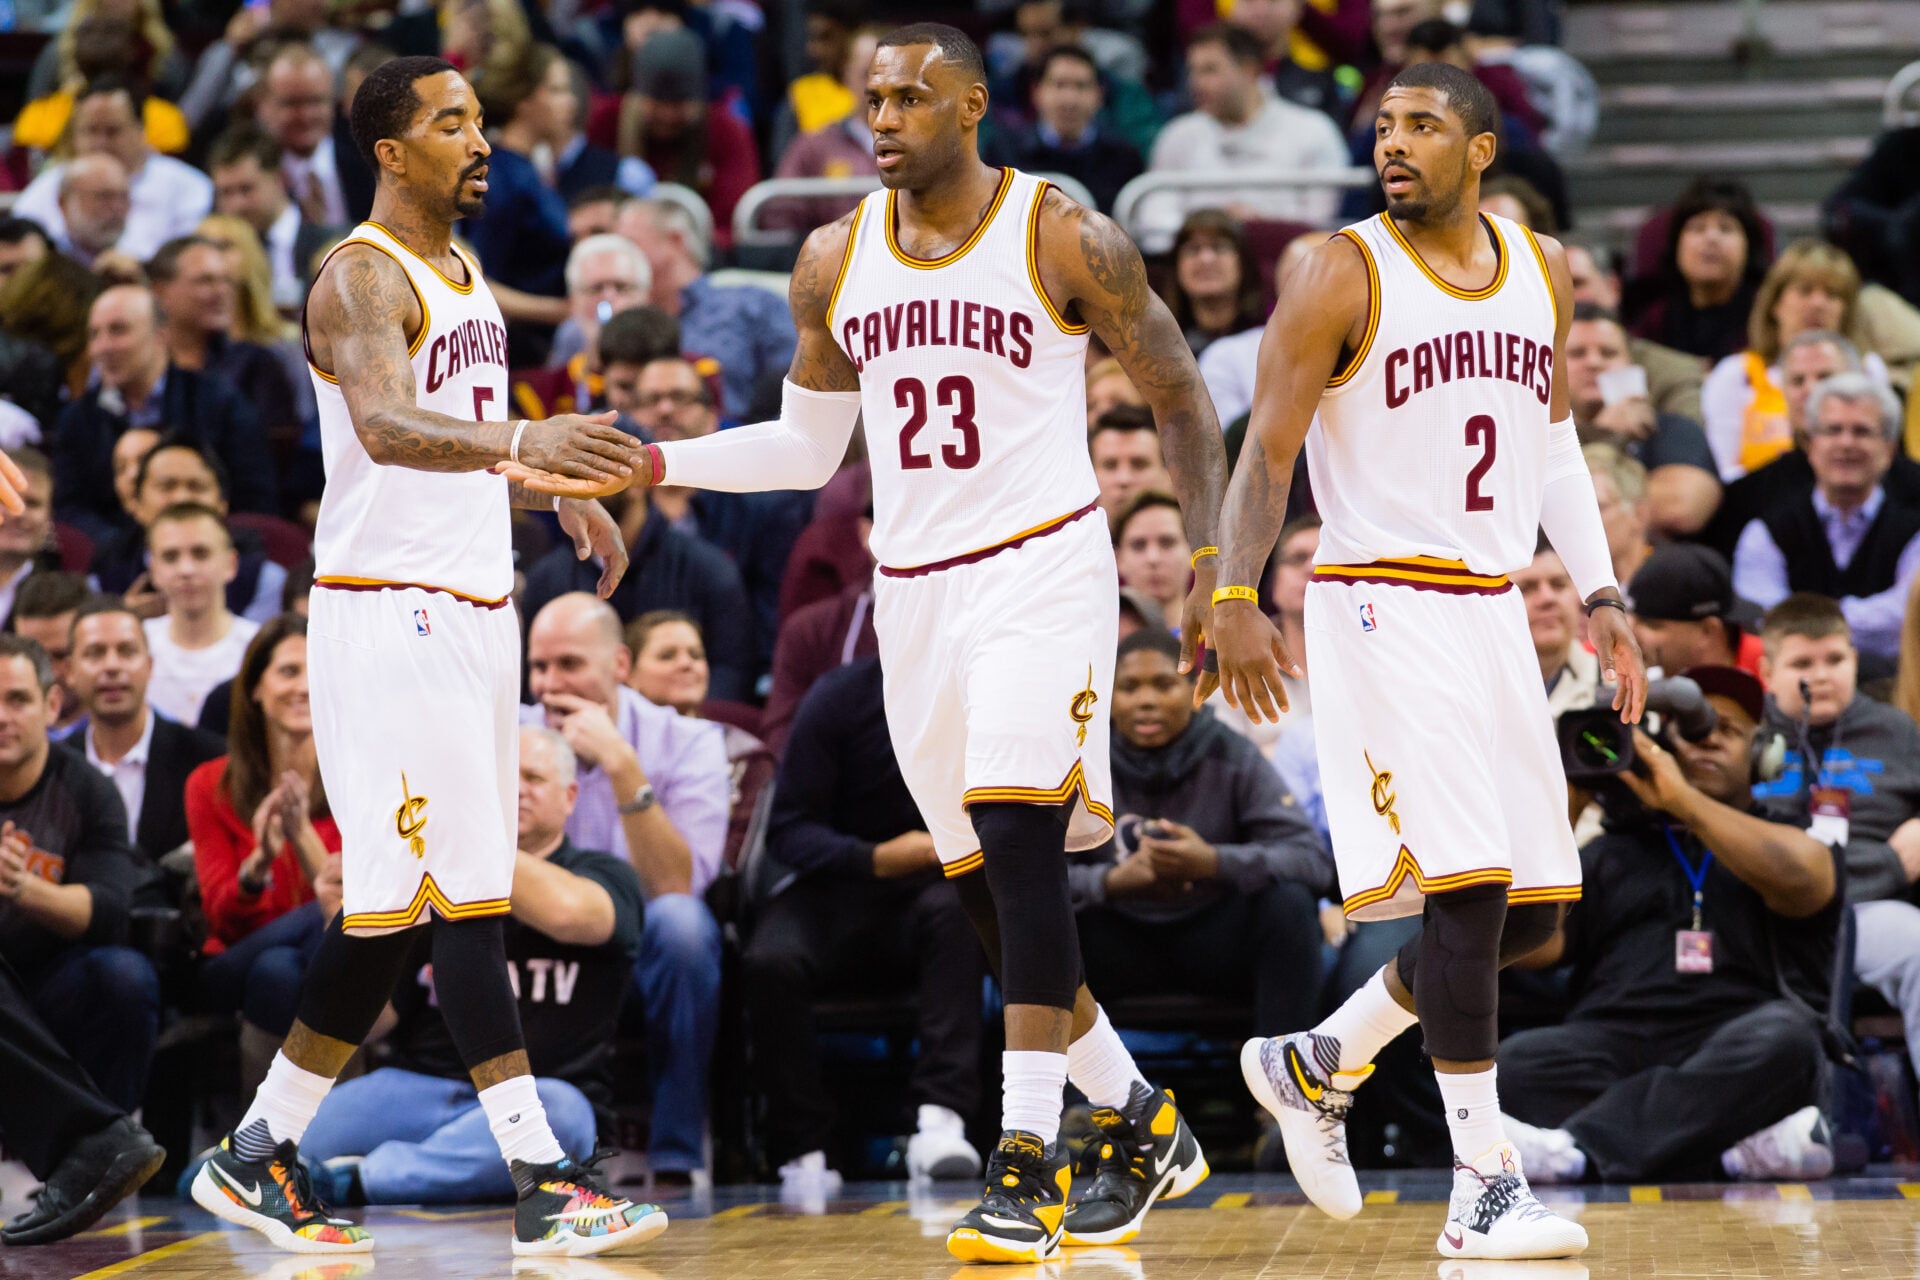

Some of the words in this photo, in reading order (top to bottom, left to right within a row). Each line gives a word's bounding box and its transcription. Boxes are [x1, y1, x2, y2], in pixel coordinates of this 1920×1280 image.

[843, 299, 1034, 374] CAVALIERS
[1384, 330, 1553, 410] CAVALIERS
[893, 375, 981, 470] 23
[1465, 414, 1497, 512] 2
[1228, 588, 1246, 596] FLY
[526, 958, 580, 1005] TV
